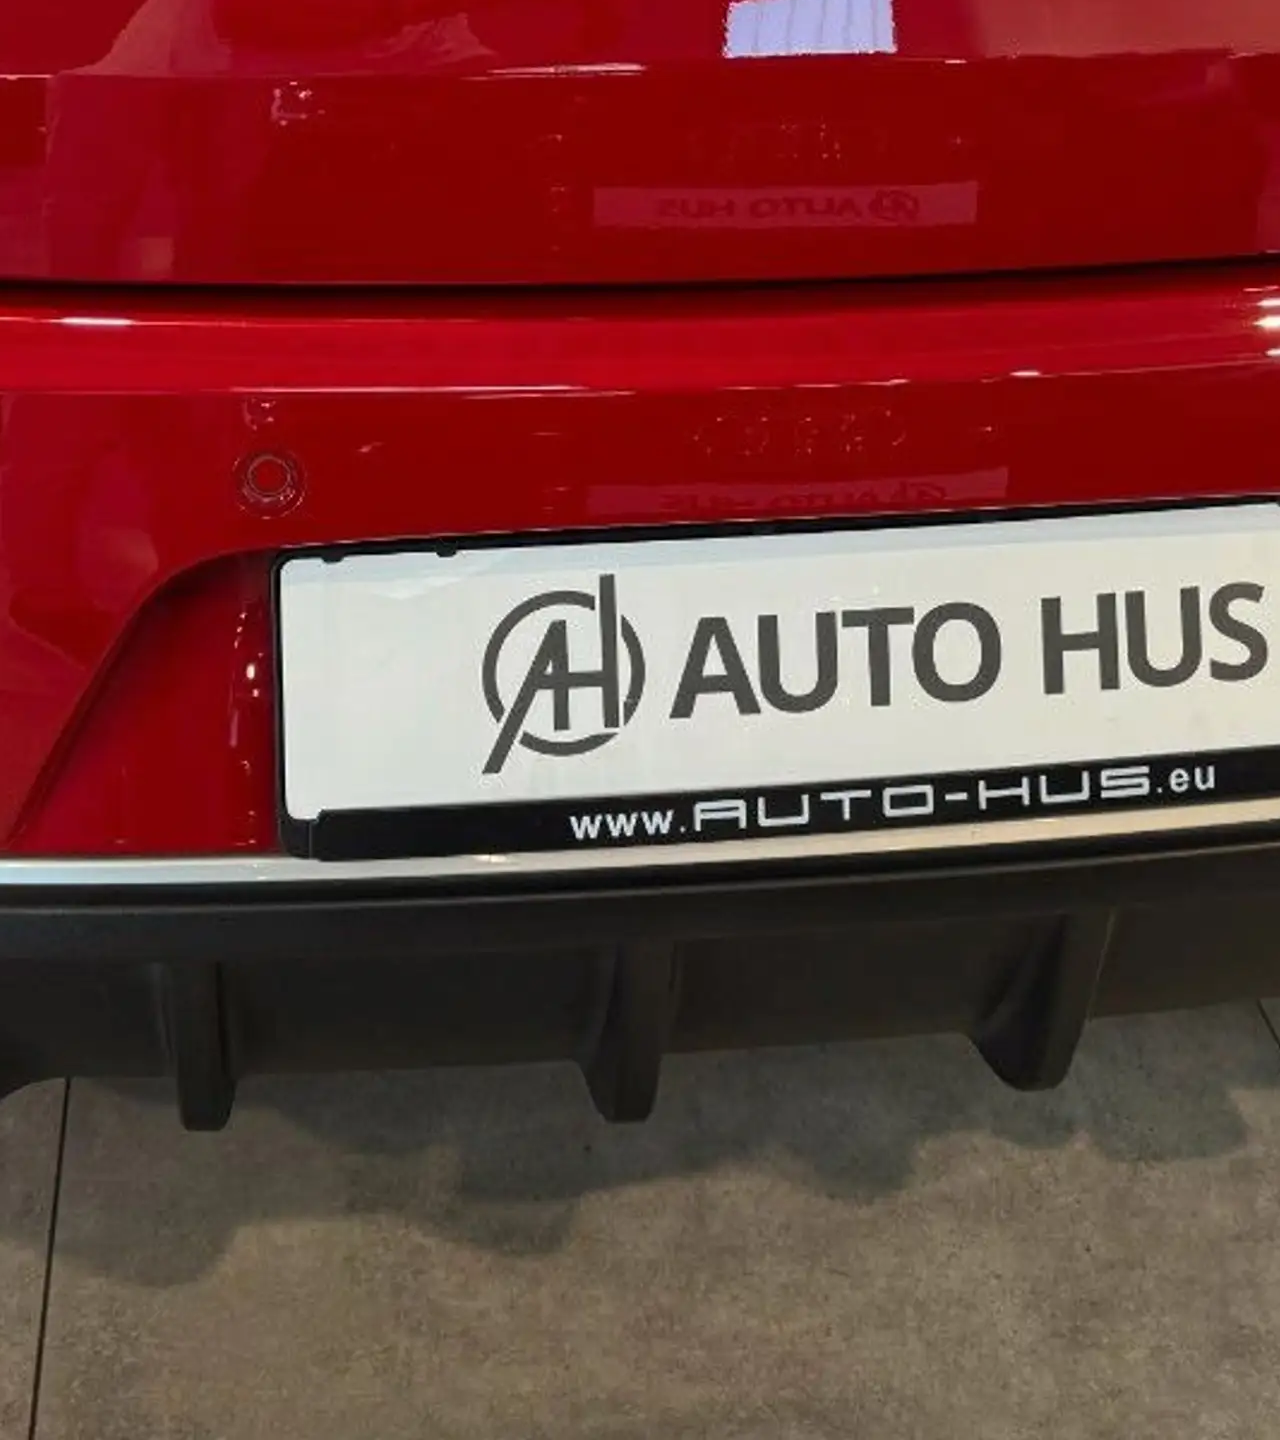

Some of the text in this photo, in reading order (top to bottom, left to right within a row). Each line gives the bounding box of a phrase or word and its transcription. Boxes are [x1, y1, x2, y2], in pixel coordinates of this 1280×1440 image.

[669, 601, 1002, 720] AUTO
[1040, 581, 1269, 695] HUS
[569, 764, 1216, 841] www.AUTO-HUS.eu
